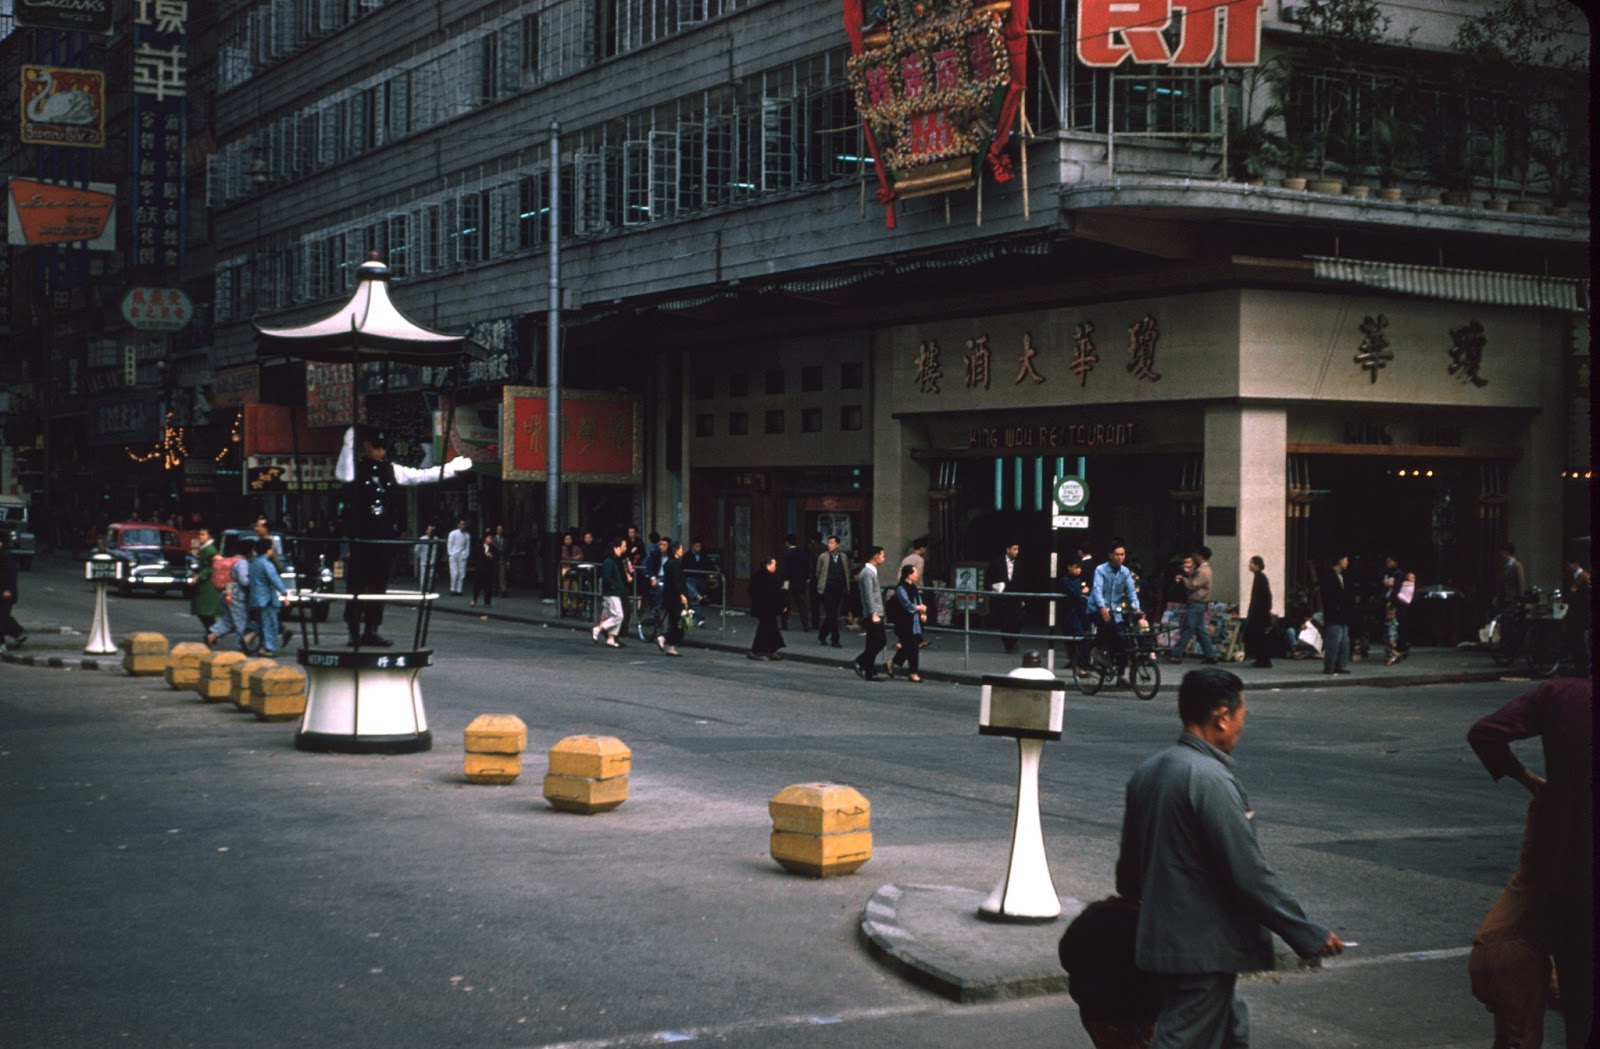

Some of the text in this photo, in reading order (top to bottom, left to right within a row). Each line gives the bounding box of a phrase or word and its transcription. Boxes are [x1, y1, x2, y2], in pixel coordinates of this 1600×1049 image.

[914, 315, 1161, 394] 瓊華大酒樓
[322, 655, 339, 666] LEFT
